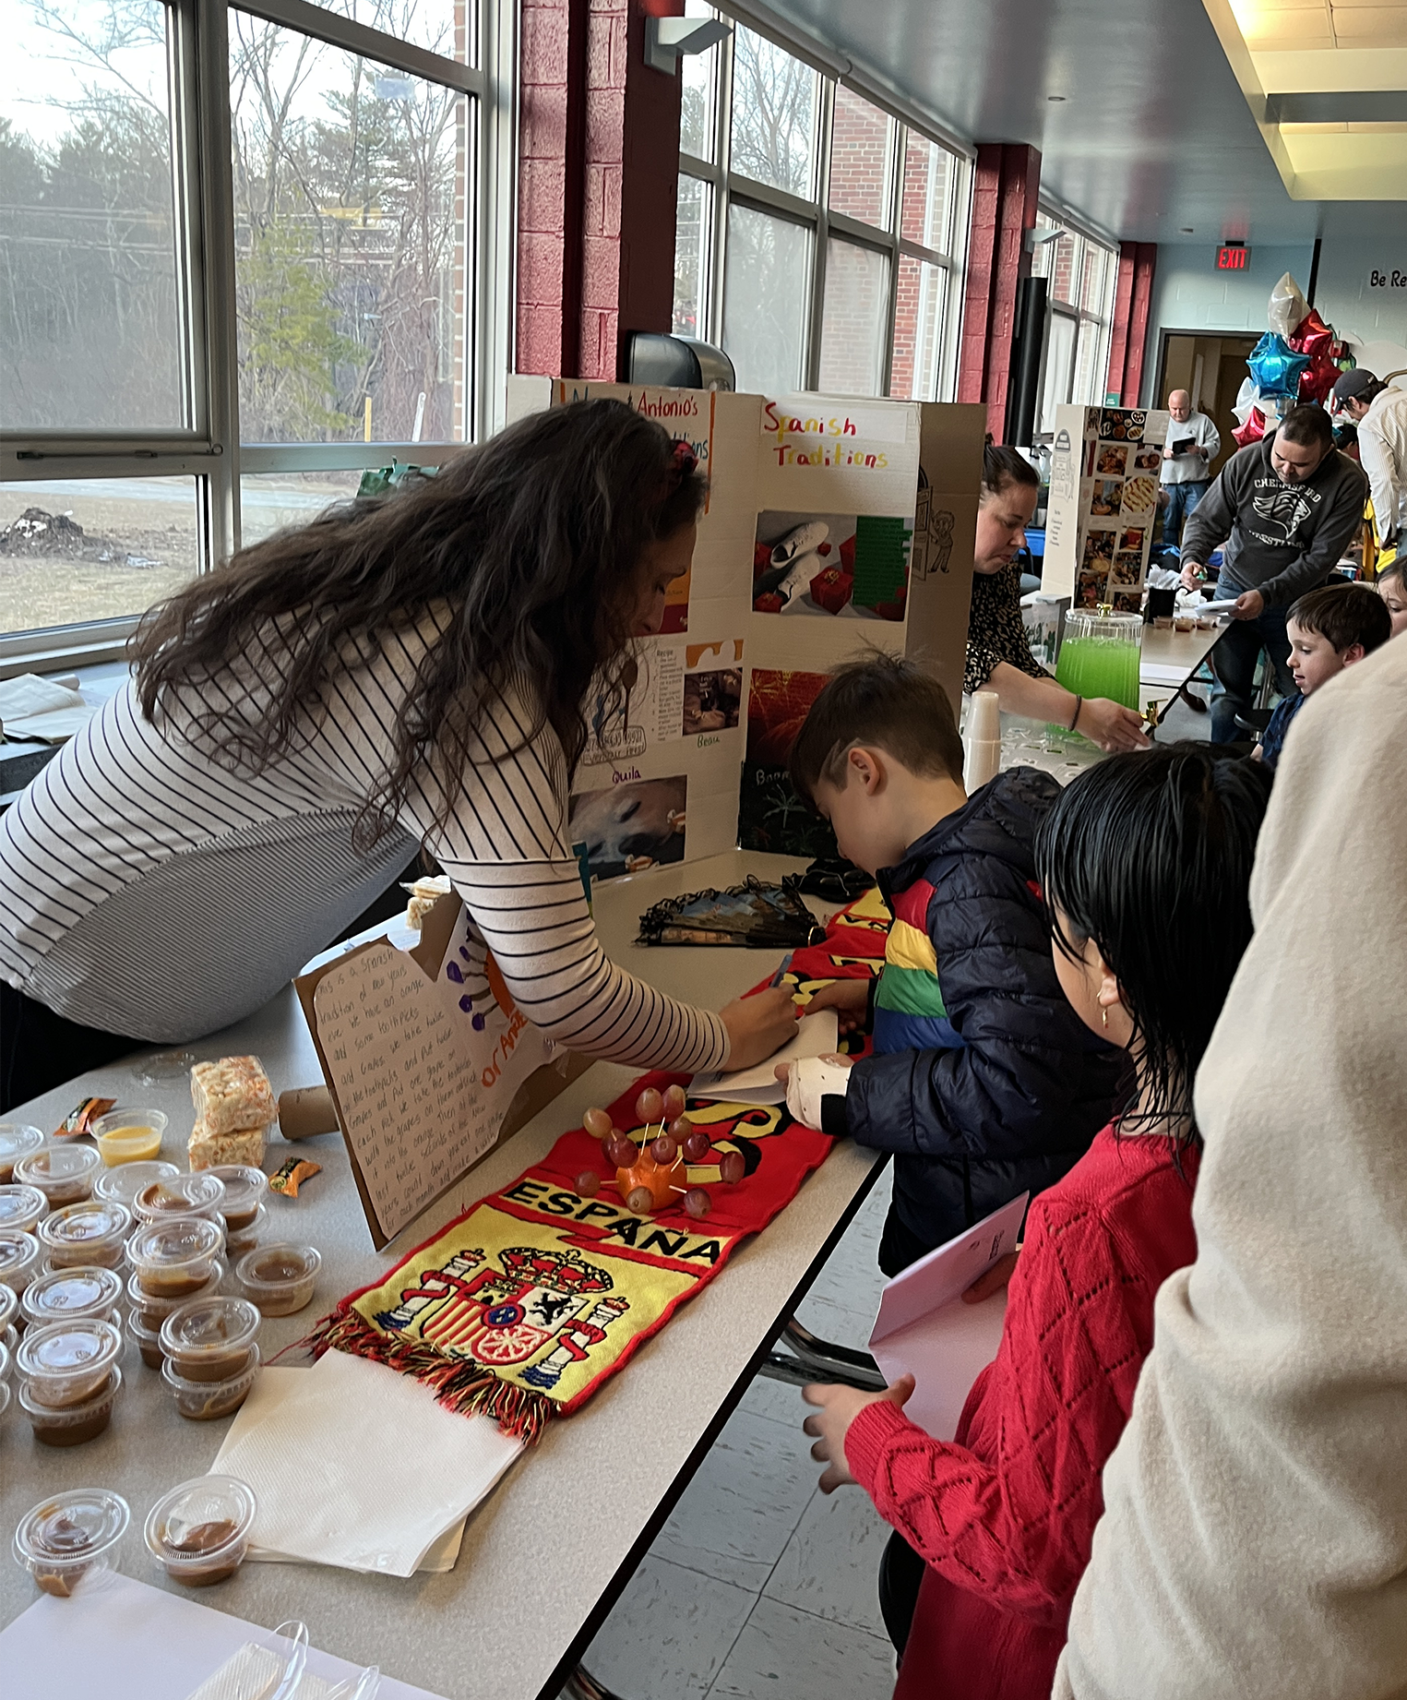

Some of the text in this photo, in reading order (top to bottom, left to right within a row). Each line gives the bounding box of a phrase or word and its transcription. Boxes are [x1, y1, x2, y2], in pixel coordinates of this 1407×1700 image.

[1218, 248, 1247, 269] EXIT
[1370, 269, 1387, 287] Be
[637, 391, 699, 418] Antonio's
[764, 402, 857, 443] Spanish
[773, 443, 889, 469] Traditions
[502, 1180, 722, 1265] ESPAÑA
